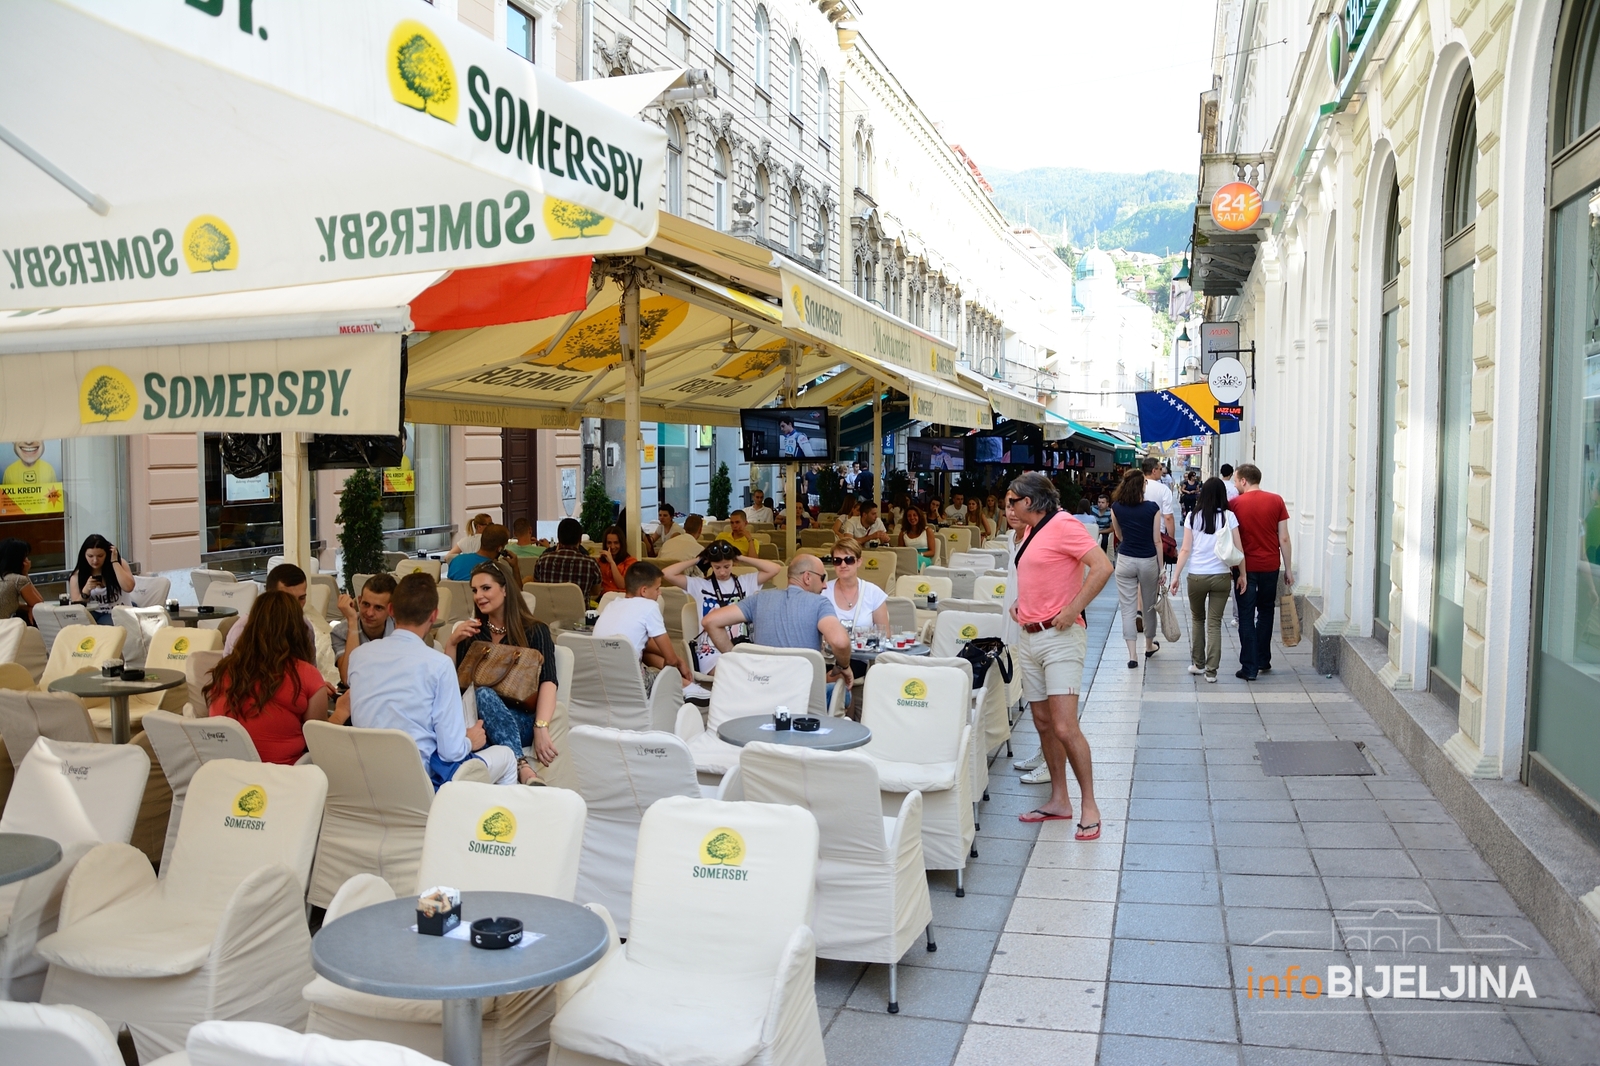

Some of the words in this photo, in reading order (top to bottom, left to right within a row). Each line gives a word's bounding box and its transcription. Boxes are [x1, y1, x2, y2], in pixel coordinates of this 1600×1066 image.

[467, 64, 644, 211] SOMERSBY.
[1217, 193, 1246, 212] 24
[1216, 212, 1246, 222] SATA
[339, 324, 375, 334] MEGASTIL
[873, 321, 911, 362] Monument
[143, 368, 351, 421] SOMERSBY.
[2, 487, 16, 495] XXL
[18, 486, 42, 494] KREDIT
